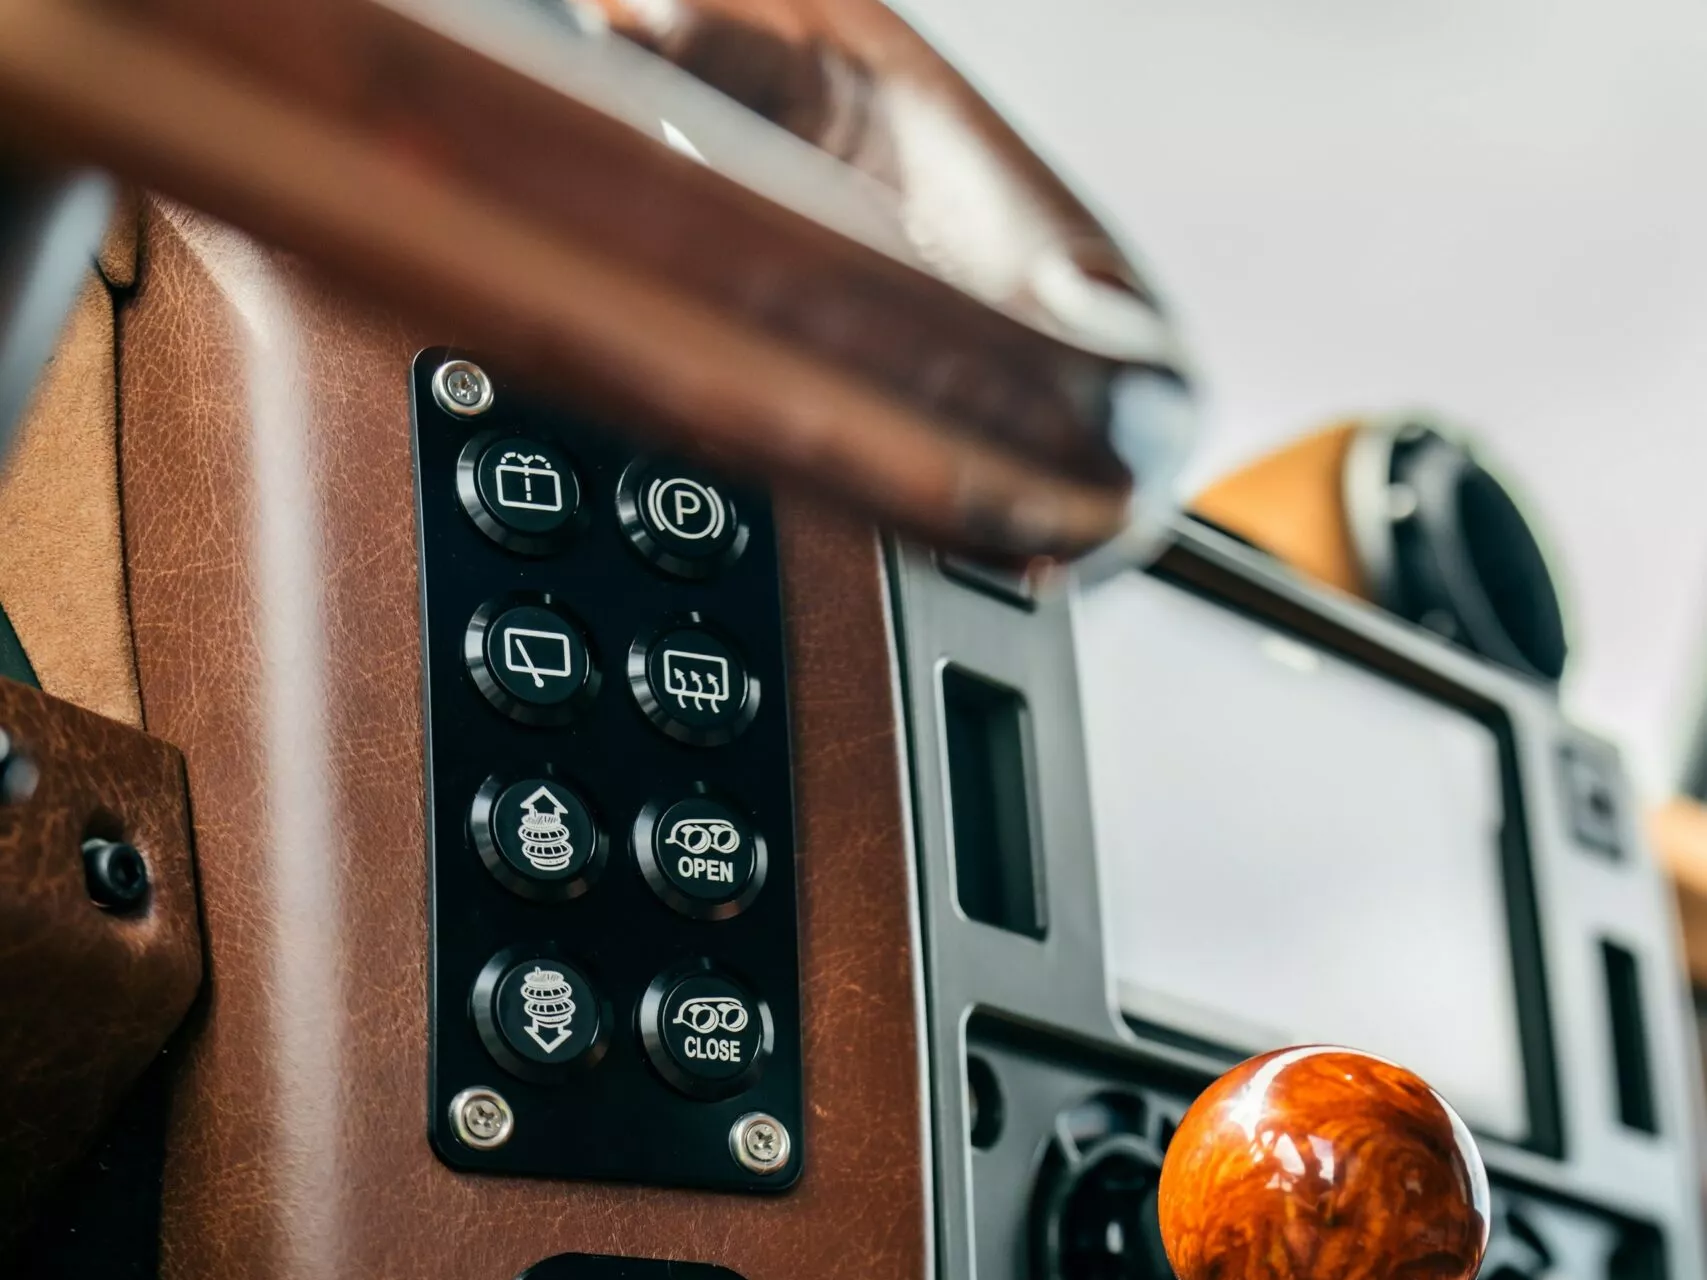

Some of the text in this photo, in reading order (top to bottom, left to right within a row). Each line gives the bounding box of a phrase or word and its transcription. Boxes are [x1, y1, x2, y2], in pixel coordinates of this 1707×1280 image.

[674, 490, 701, 525] P
[677, 856, 734, 883] OPEN
[684, 1036, 741, 1063] CLOSE
